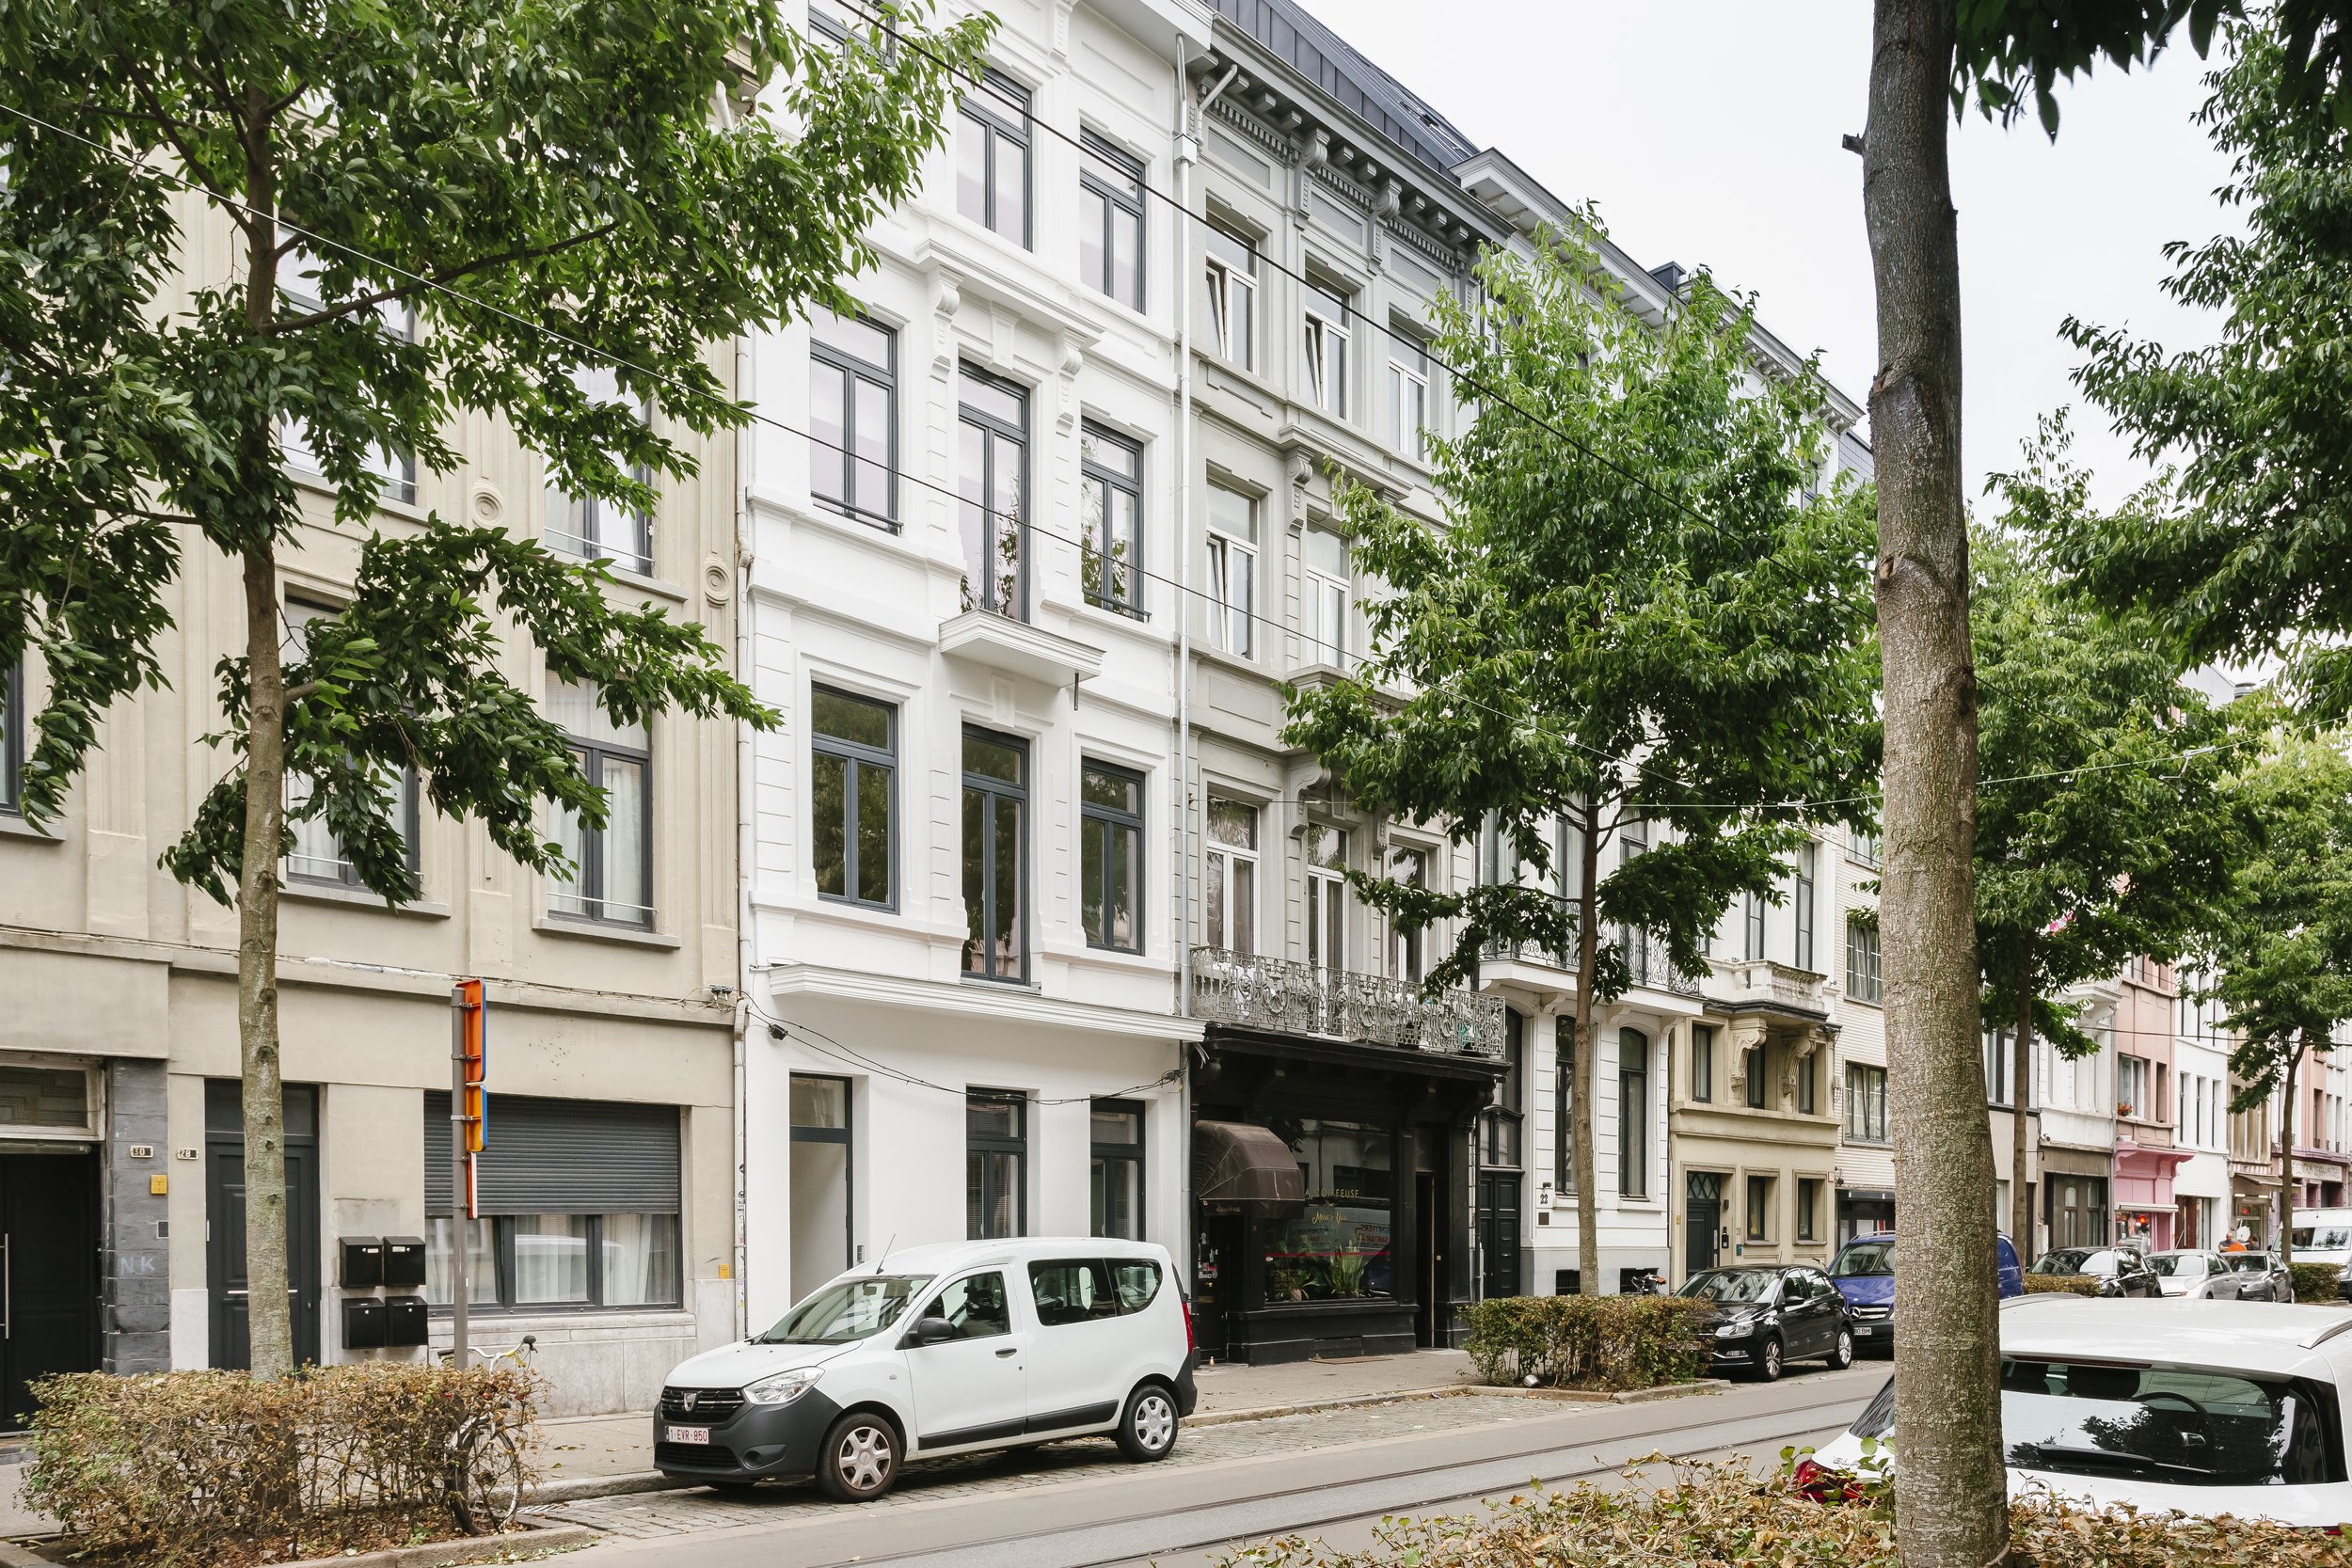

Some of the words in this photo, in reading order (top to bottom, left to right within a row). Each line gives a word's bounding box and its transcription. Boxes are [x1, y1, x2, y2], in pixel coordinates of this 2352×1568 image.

[134, 1148, 146, 1156] 30
[180, 1148, 191, 1158] 28
[1540, 1194, 1549, 1204] 22
